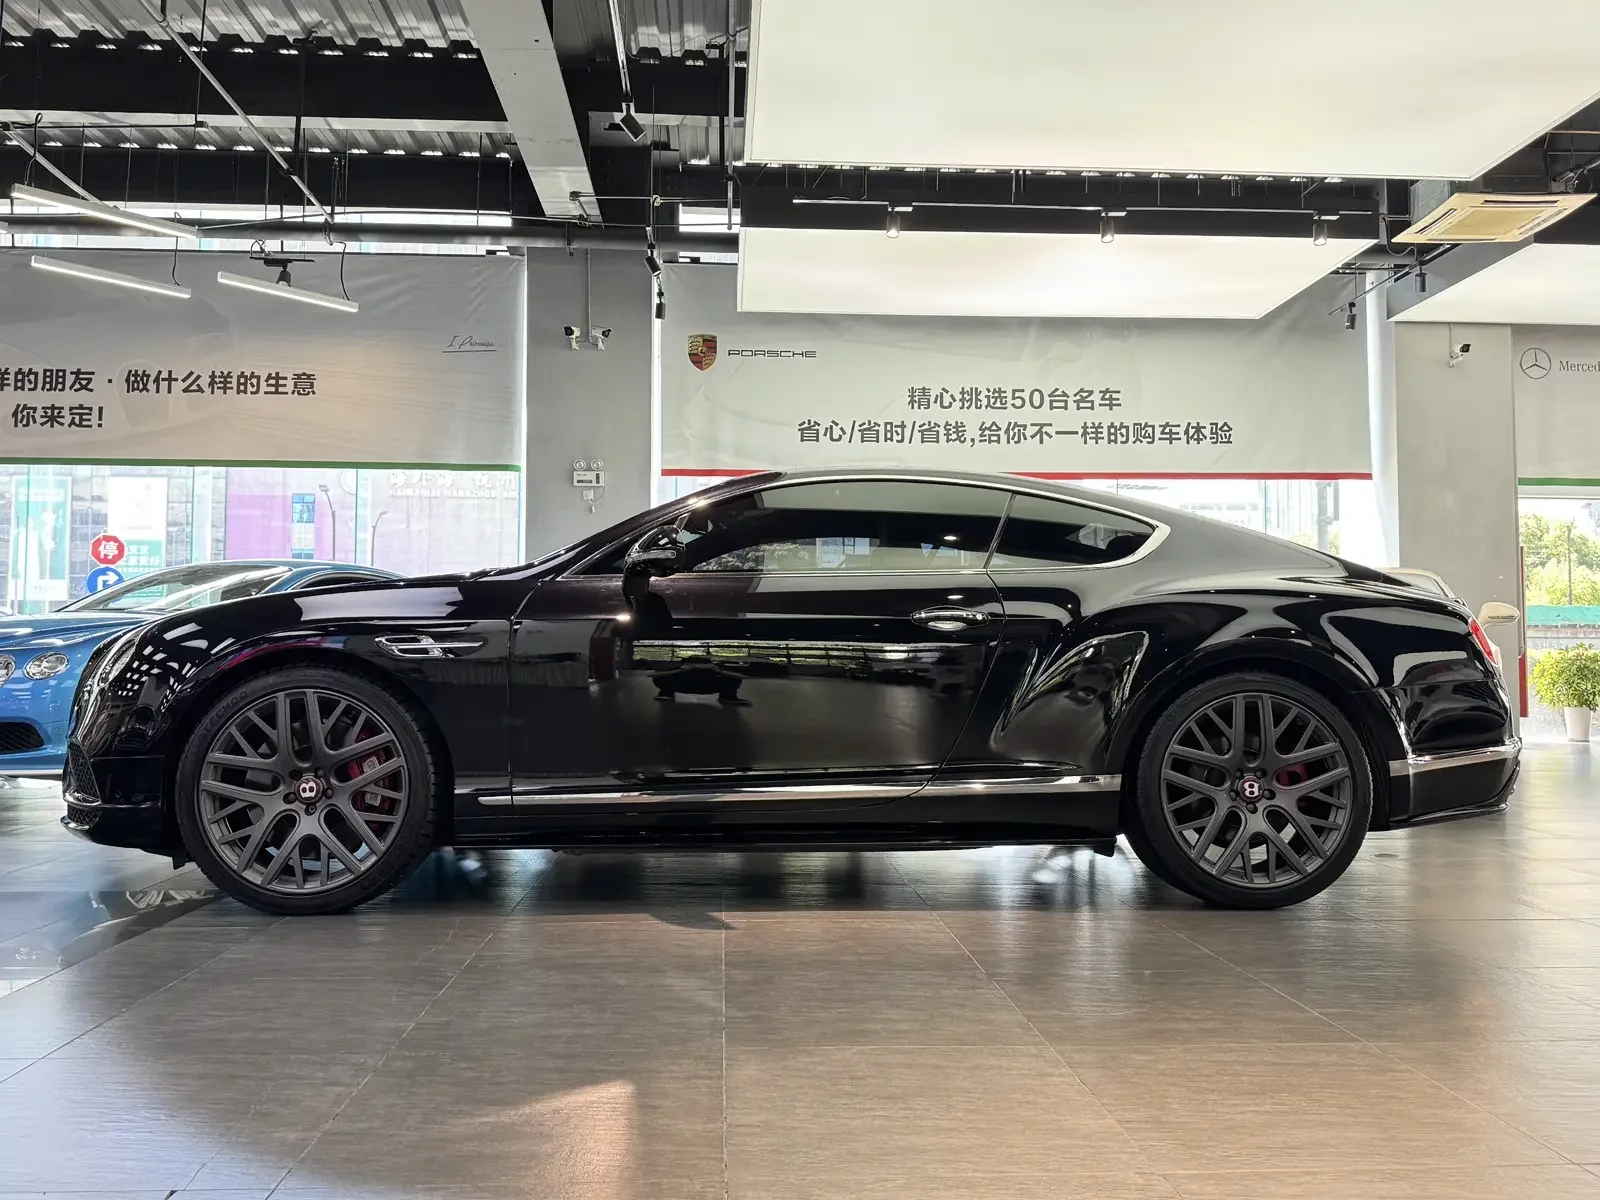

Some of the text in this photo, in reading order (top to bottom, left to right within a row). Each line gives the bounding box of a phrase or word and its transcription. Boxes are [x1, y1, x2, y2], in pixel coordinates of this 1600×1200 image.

[727, 349, 817, 358] PORSCHE
[1559, 360, 1600, 372] Merced
[907, 386, 1122, 411] 精心挑选50台名车
[98, 540, 119, 560] 停
